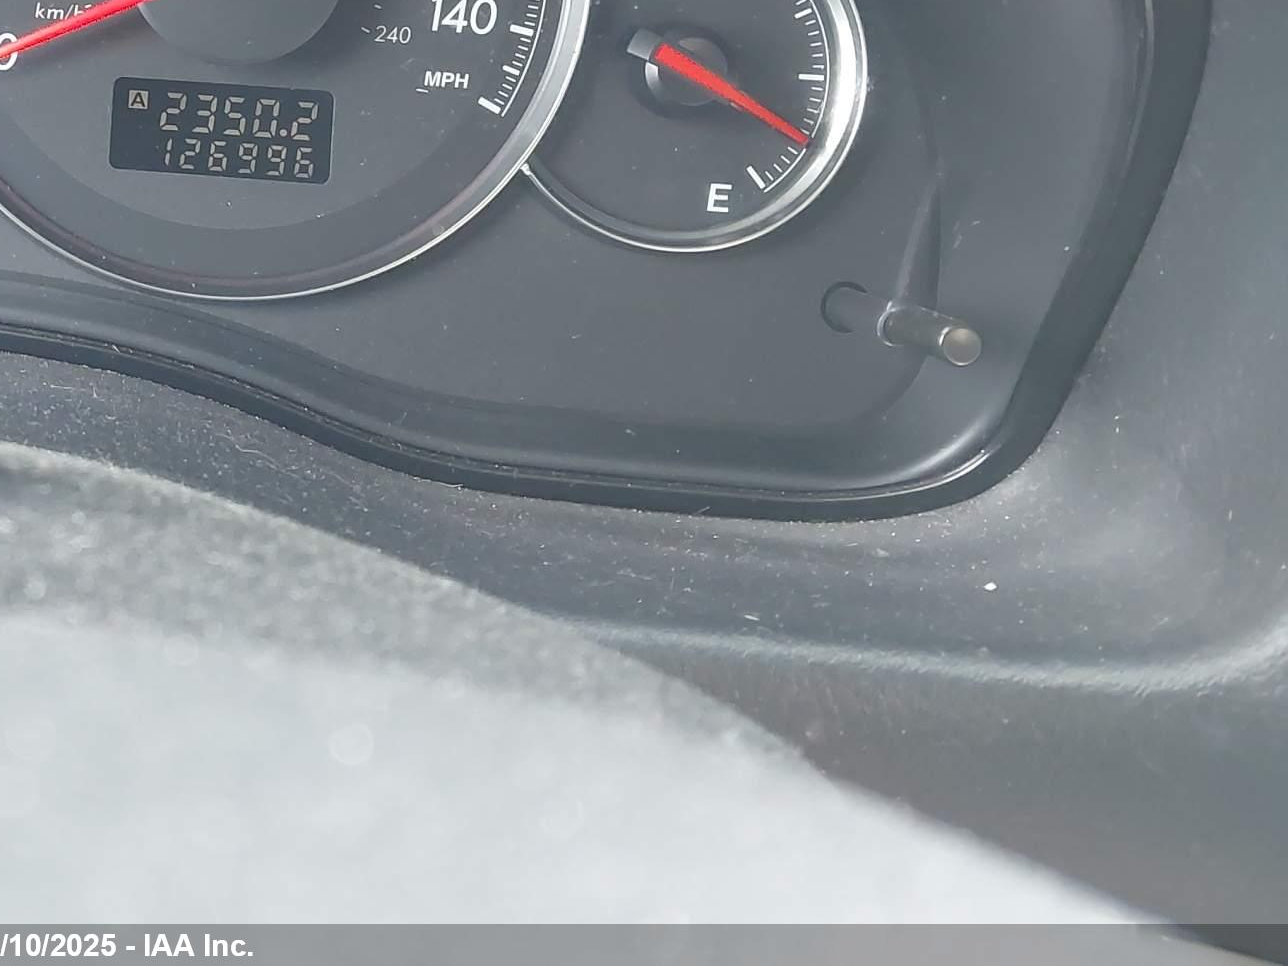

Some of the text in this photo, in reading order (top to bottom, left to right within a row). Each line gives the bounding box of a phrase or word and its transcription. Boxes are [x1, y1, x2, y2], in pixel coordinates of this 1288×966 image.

[375, 26, 410, 43] 240
[425, 71, 469, 88] MPH
[130, 91, 147, 108] A
[160, 92, 318, 141] 2350.2
[164, 137, 314, 178] 126996
[707, 184, 731, 212] E
